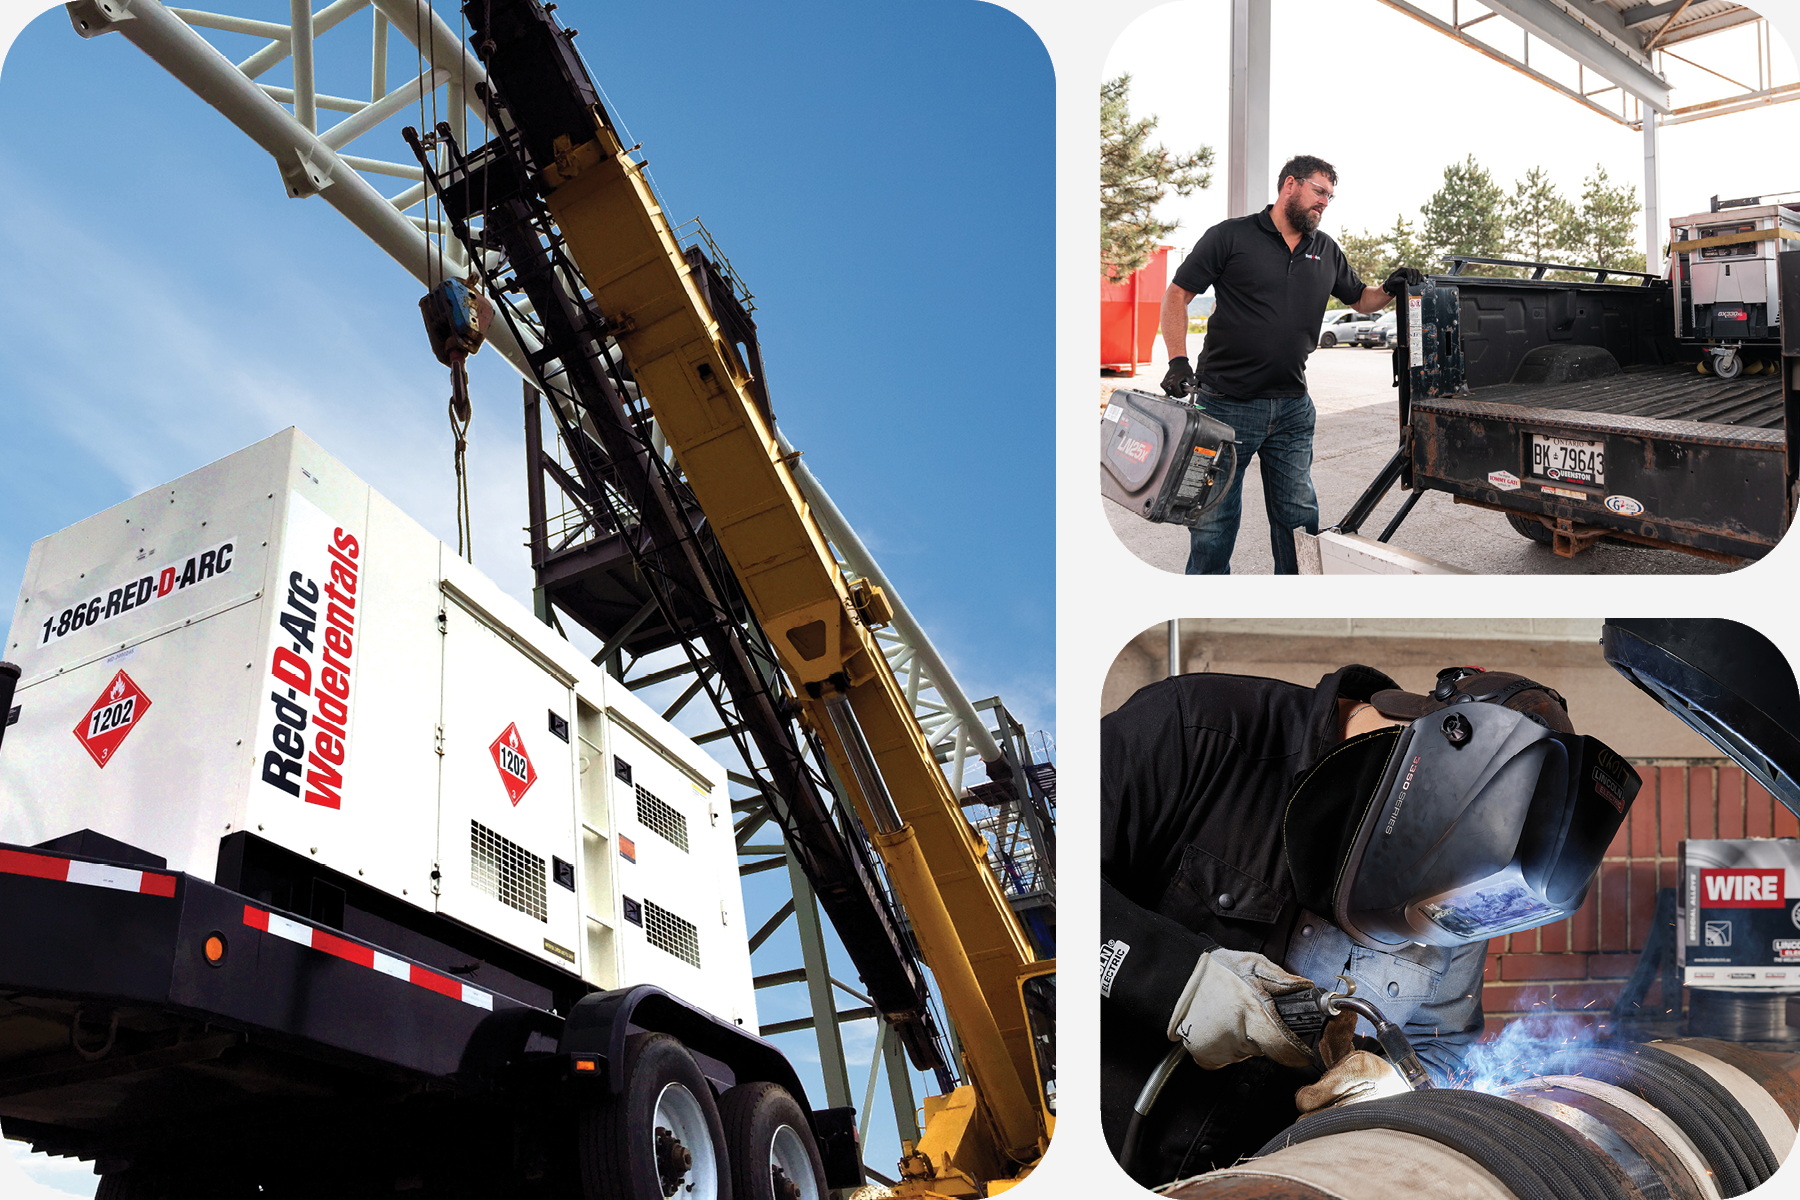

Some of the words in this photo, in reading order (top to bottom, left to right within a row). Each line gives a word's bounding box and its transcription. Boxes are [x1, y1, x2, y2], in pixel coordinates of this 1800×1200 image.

[1534, 443, 1551, 467] BK
[1560, 446, 1604, 475] 79643
[1547, 467, 1591, 481] QUEENSTON
[41, 542, 234, 645] 1-866-RED-D-ARC
[262, 570, 320, 799] Red-D-Arc
[304, 526, 360, 811] Welderentals
[92, 699, 134, 735] 1202
[101, 748, 108, 759] 3
[501, 746, 526, 781] 1202
[1402, 755, 1421, 791] 3350
[1594, 769, 1623, 799] LINCOLN
[511, 789, 516, 799] 3
[1599, 785, 1622, 809] ELECTRIC
[1385, 790, 1407, 835] SERIES
[1704, 875, 1778, 901] WIRE
[1101, 948, 1125, 993] ELECTRIC
